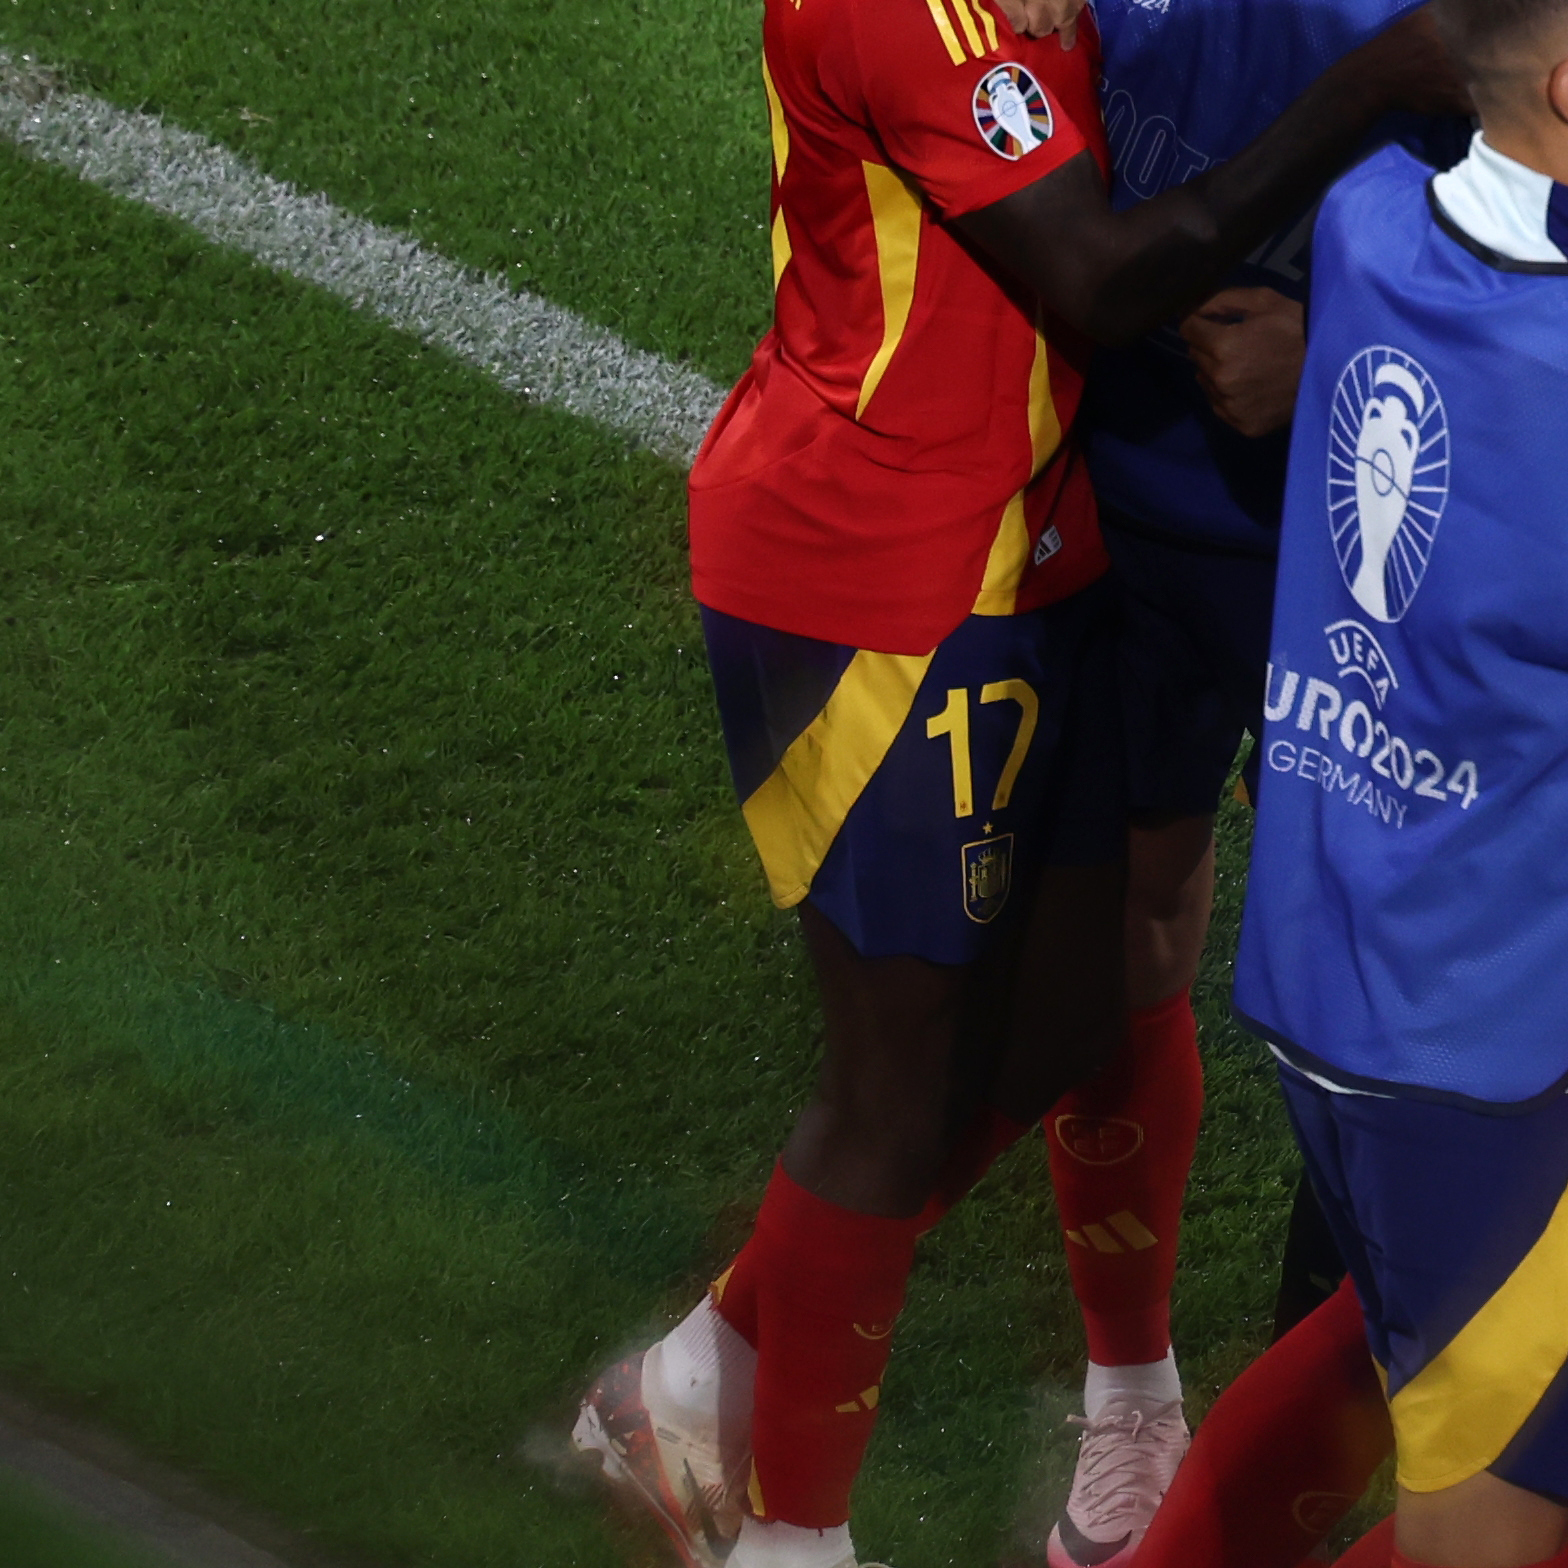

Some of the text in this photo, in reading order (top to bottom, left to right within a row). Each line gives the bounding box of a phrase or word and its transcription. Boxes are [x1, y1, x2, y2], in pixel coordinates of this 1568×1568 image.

[1328, 630, 1390, 705] UEFA
[926, 678, 1039, 819] 17
[1263, 661, 1479, 811] URO2024
[1268, 740, 1408, 830] GERMANY
